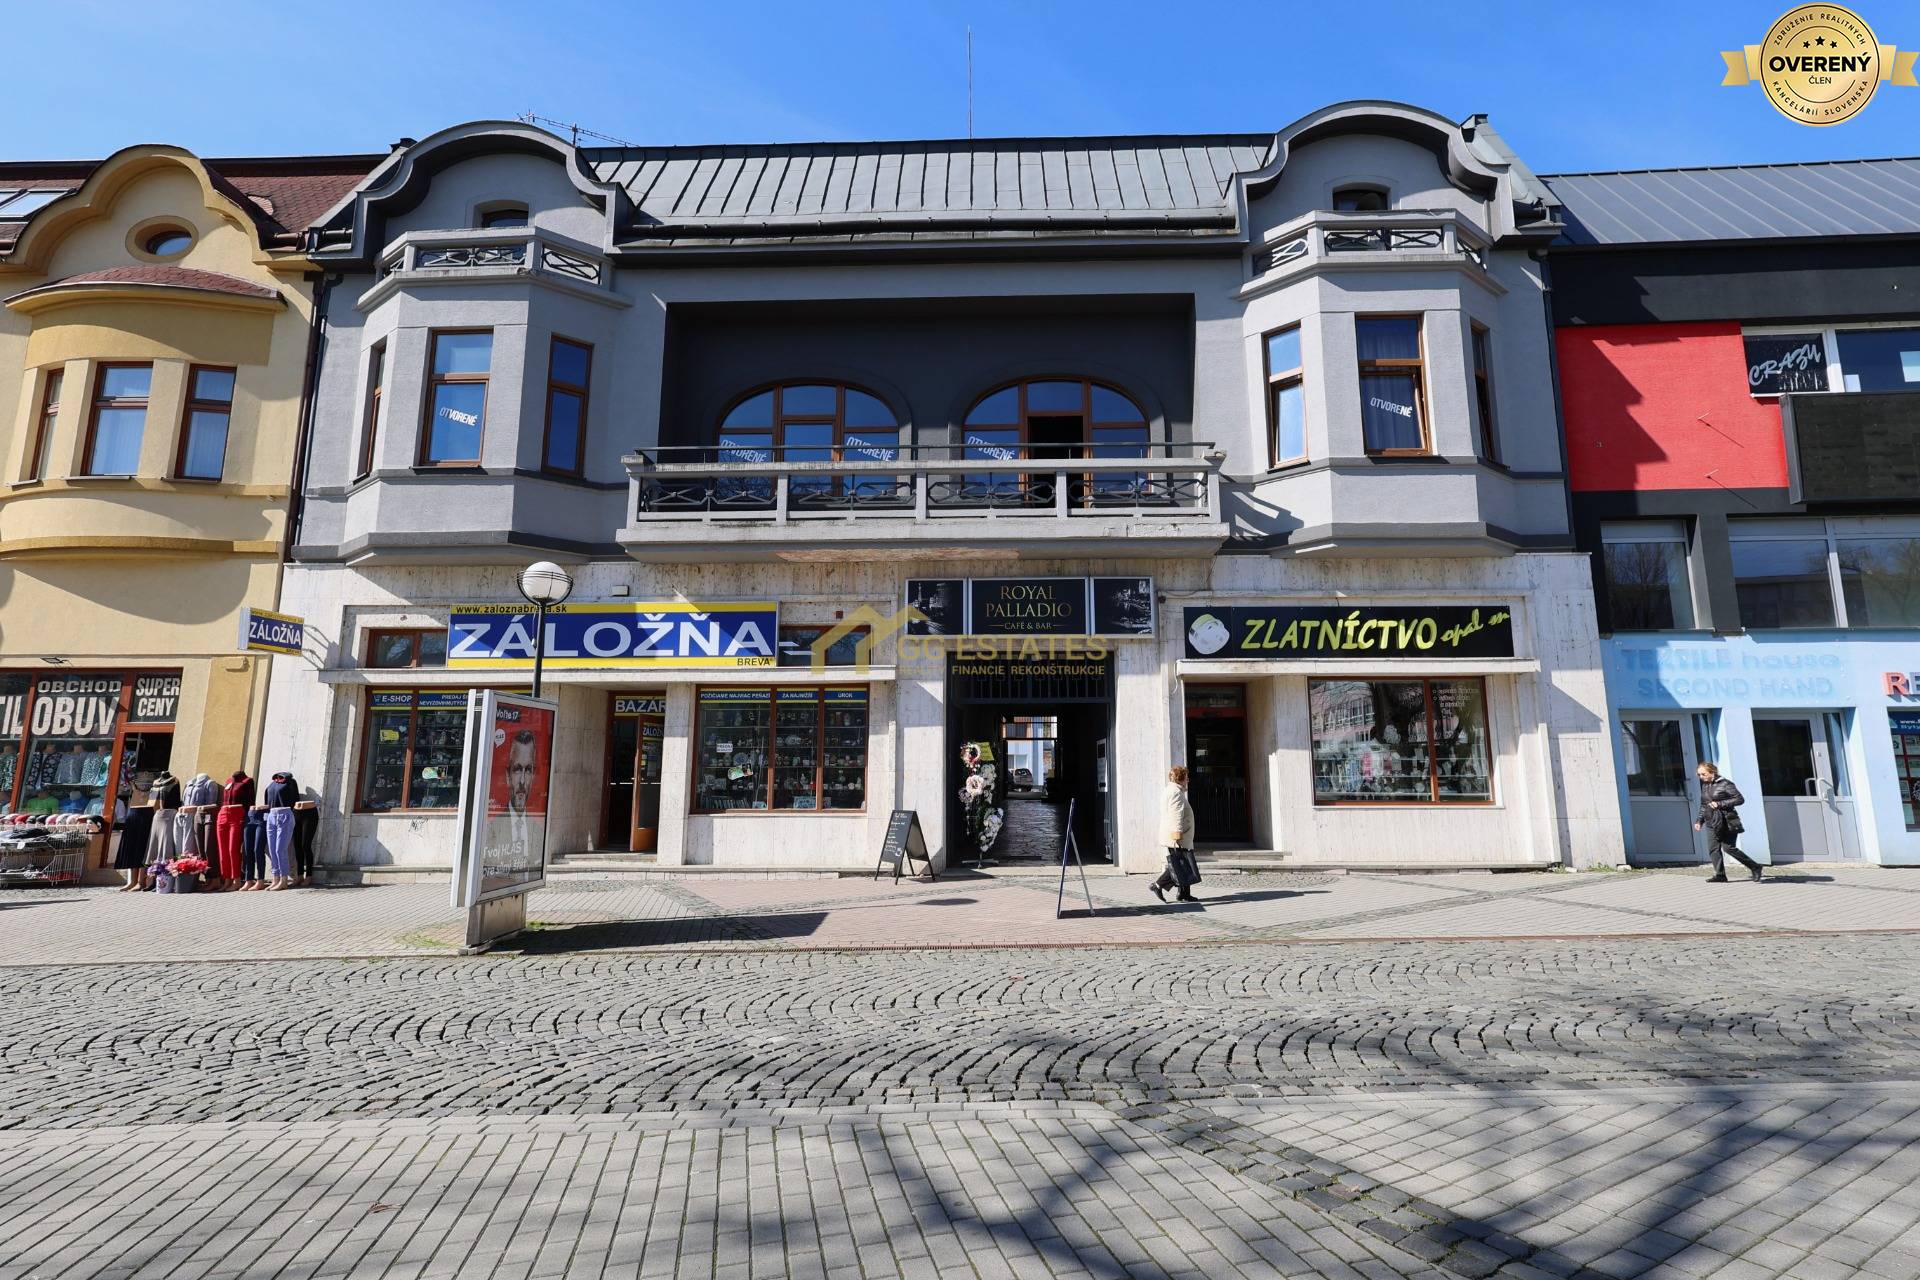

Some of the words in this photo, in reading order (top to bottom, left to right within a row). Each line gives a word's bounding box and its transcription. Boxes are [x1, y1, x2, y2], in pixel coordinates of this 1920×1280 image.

[439, 406, 479, 426] OTVORENÉ
[1370, 397, 1413, 418] OTVORENÉ
[1001, 585, 1056, 600] ROYAL
[986, 602, 1072, 617] PALLADIO
[249, 620, 302, 646] ZÁLOŽŇA
[449, 613, 774, 658] ZÁLOŽŇA
[1036, 622, 1052, 630] BAR
[1240, 610, 1438, 650] ZLATNÍCTVO
[37, 681, 122, 693] OBCHOD
[136, 678, 181, 697] SUPER
[1638, 678, 1749, 699] SECOND
[1760, 678, 1834, 698] HAND
[137, 698, 175, 717] CENY
[382, 695, 412, 703] E-SHOP
[31, 696, 121, 736] OBUV
